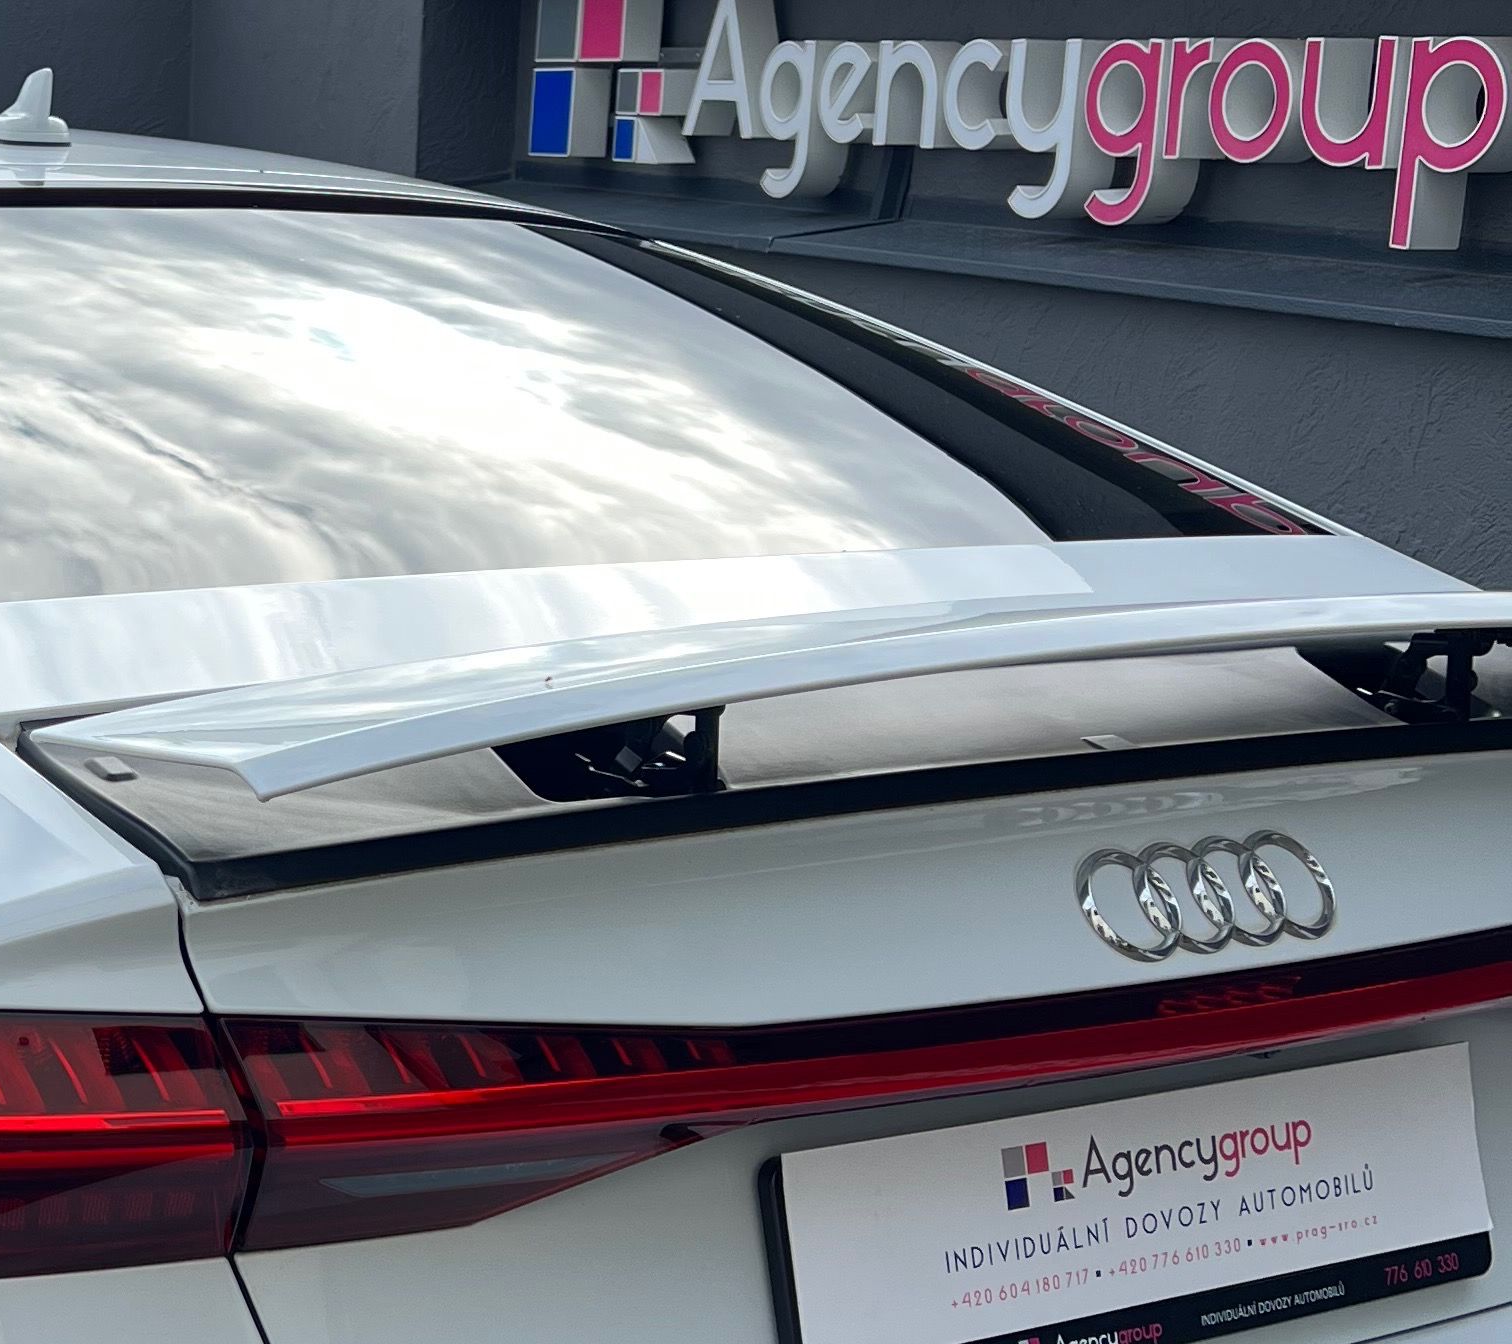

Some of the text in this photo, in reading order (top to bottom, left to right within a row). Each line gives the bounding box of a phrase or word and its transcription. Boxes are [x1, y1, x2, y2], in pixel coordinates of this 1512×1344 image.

[1082, 1119, 1312, 1197] Agencygroup
[944, 1163, 1374, 1273] INDIVIDUÁLNÍ DOVOZY AUTOMOBILŮ
[951, 1288, 993, 1309] +420
[999, 1280, 1031, 1301] 604
[1035, 1273, 1061, 1295] 180
[1065, 1267, 1089, 1289] 717
[1109, 1257, 1147, 1277] +420
[1152, 1249, 1180, 1269] 776
[1185, 1243, 1210, 1263] 610
[1215, 1237, 1241, 1256] 330
